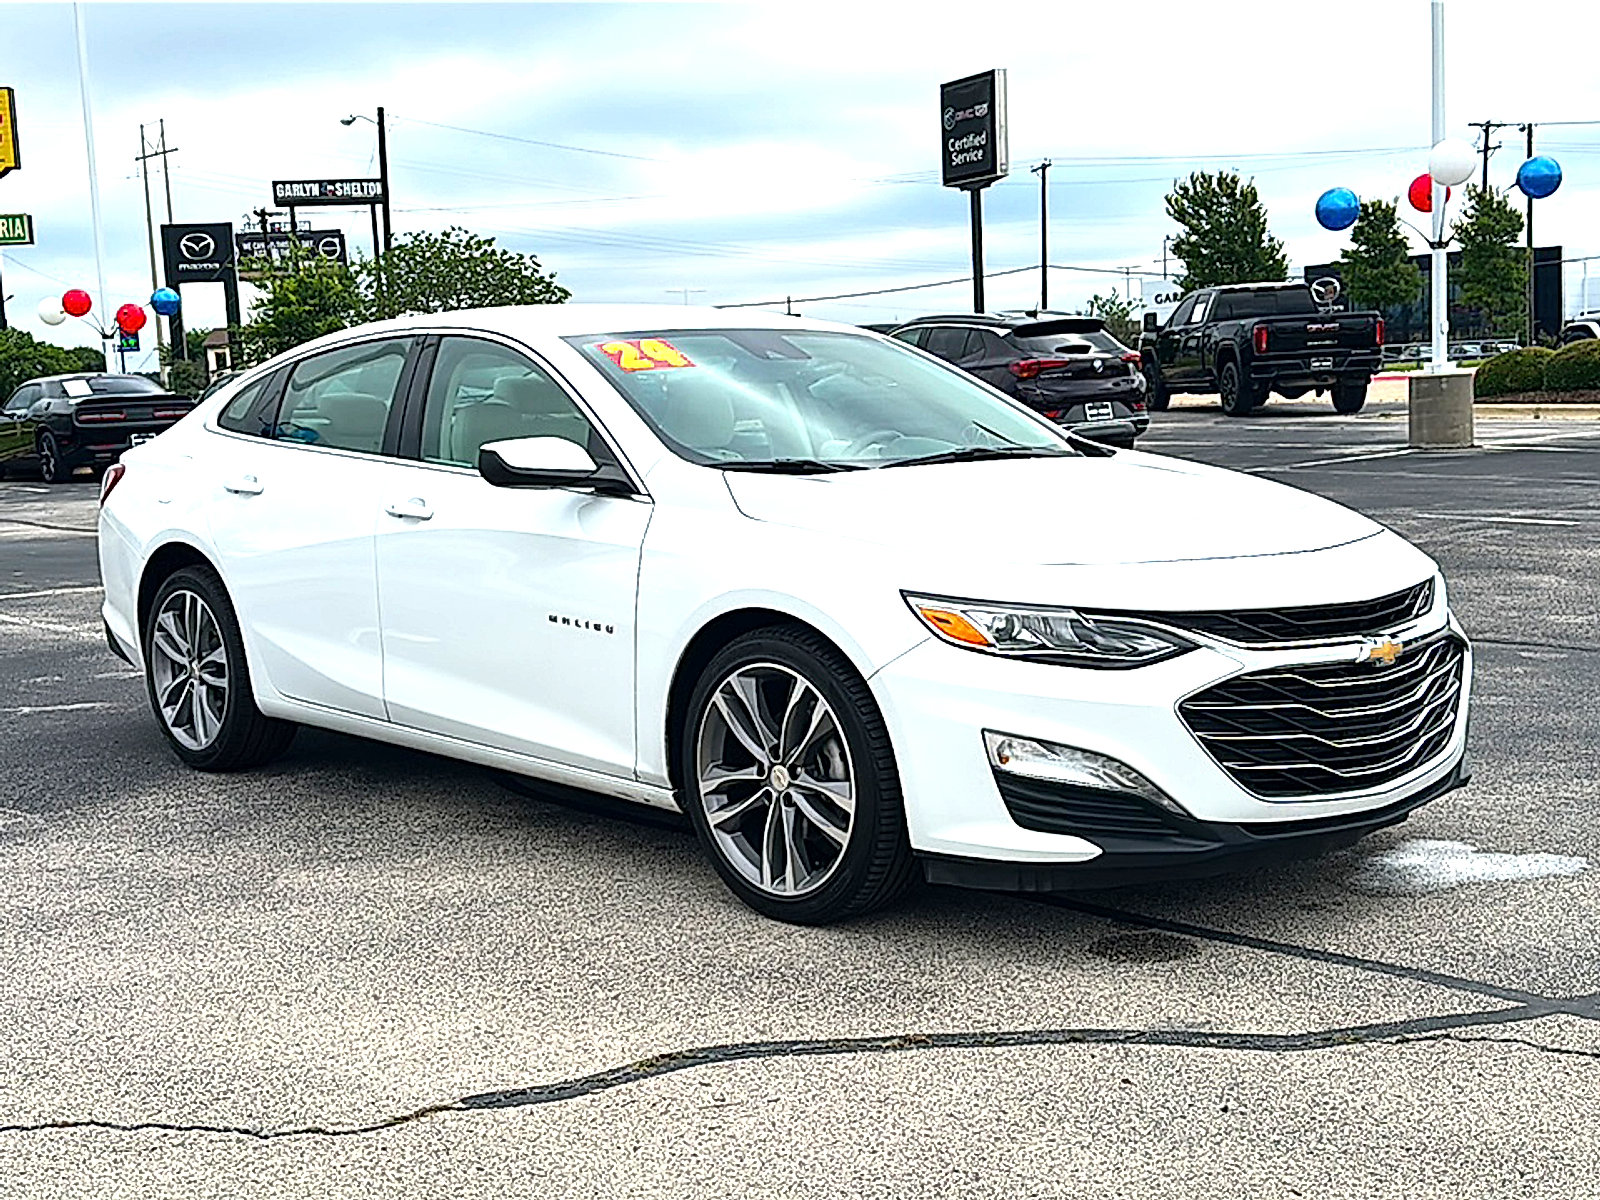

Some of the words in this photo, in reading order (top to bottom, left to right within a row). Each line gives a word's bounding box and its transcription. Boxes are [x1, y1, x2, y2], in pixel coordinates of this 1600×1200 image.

[949, 130, 986, 152] Certified
[952, 149, 983, 166] Service
[276, 183, 320, 198] GARLYN
[334, 181, 383, 197] SHELTON
[178, 263, 220, 271] mazda
[601, 339, 690, 370] 24
[548, 614, 614, 635] MALIBU
